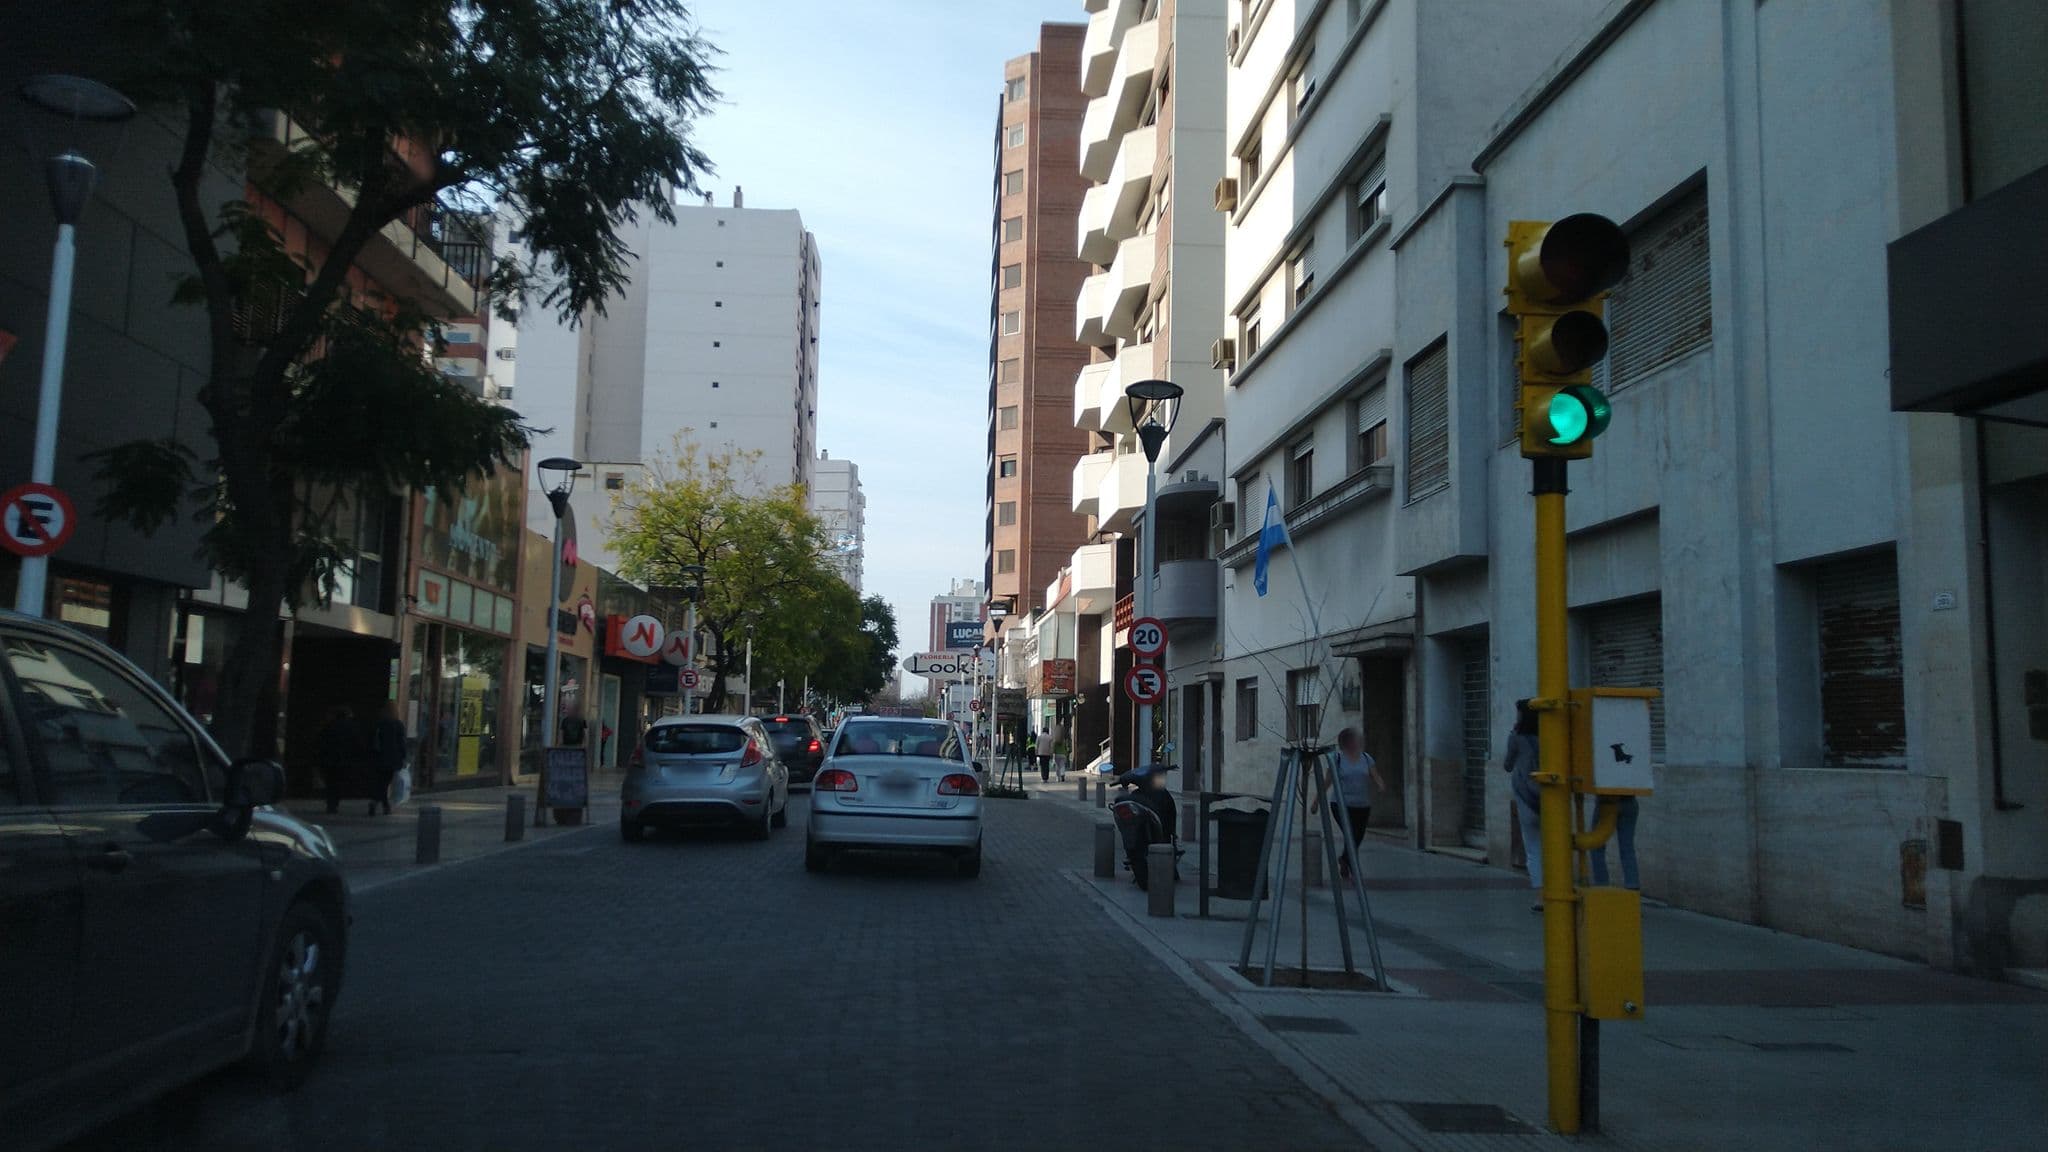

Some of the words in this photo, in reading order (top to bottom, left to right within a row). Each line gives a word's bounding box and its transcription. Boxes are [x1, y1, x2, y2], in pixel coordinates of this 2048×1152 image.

[17, 501, 53, 539] E
[630, 622, 656, 648] N
[1135, 629, 1160, 645] 20
[685, 675, 694, 685] E
[1137, 674, 1155, 695] E
